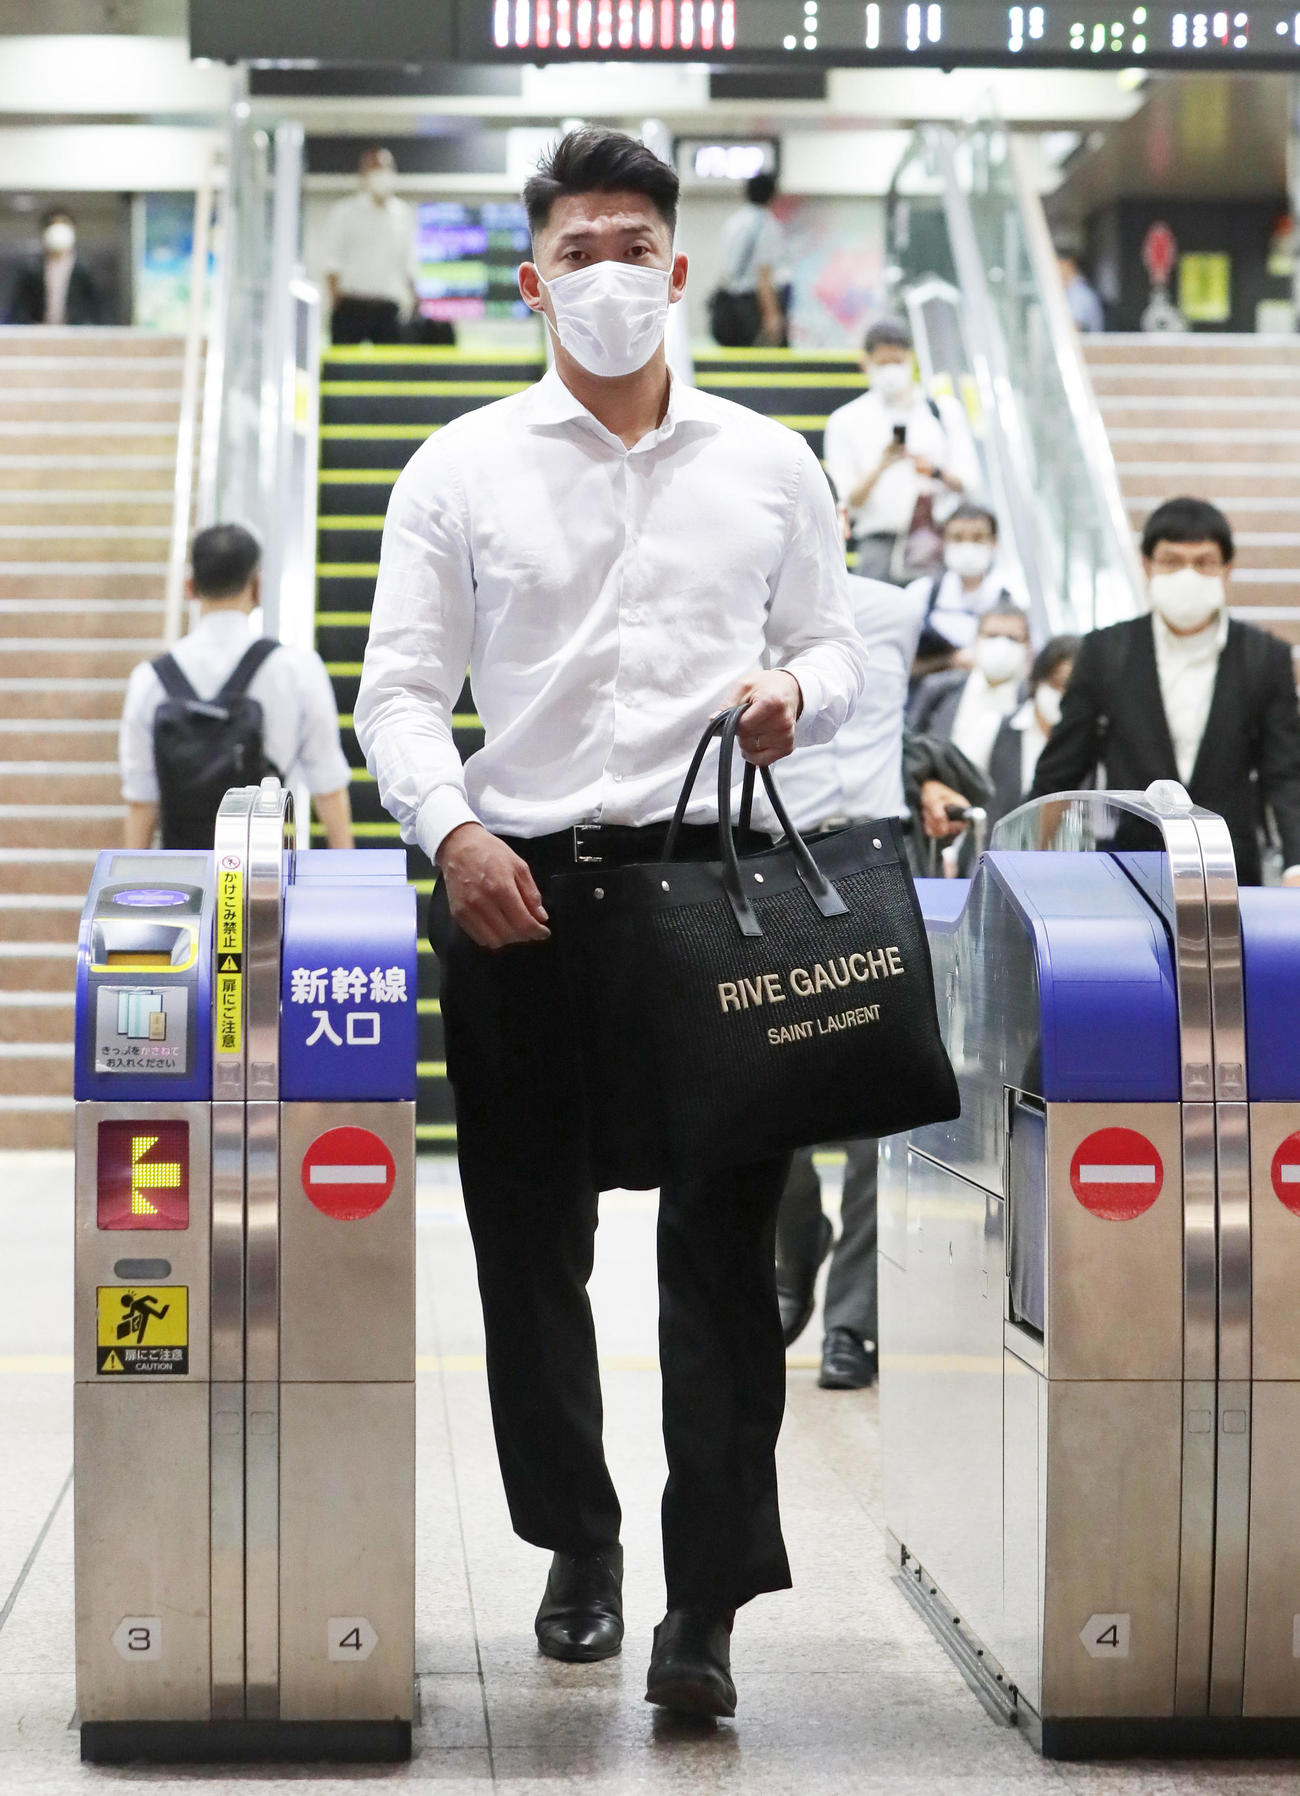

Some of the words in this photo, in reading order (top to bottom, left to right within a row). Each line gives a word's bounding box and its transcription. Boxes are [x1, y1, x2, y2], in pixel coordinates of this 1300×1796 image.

[223, 872, 237, 948] かけこみ禁止
[291, 966, 408, 1004] 新幹線
[717, 973, 786, 1013] RIVE
[789, 946, 905, 998] GAUCHE
[222, 978, 236, 1048] 扉にご注意
[305, 1010, 380, 1046] 入口
[767, 1021, 814, 1045] SAINT
[817, 1004, 881, 1035] LAURENT
[106, 1058, 176, 1068] お入れください
[125, 1348, 183, 1361] 扉にご注意
[135, 1362, 173, 1370] CAUTION
[128, 1628, 150, 1650] 3
[339, 1627, 362, 1651] 4
[1096, 1624, 1120, 1647] 4
